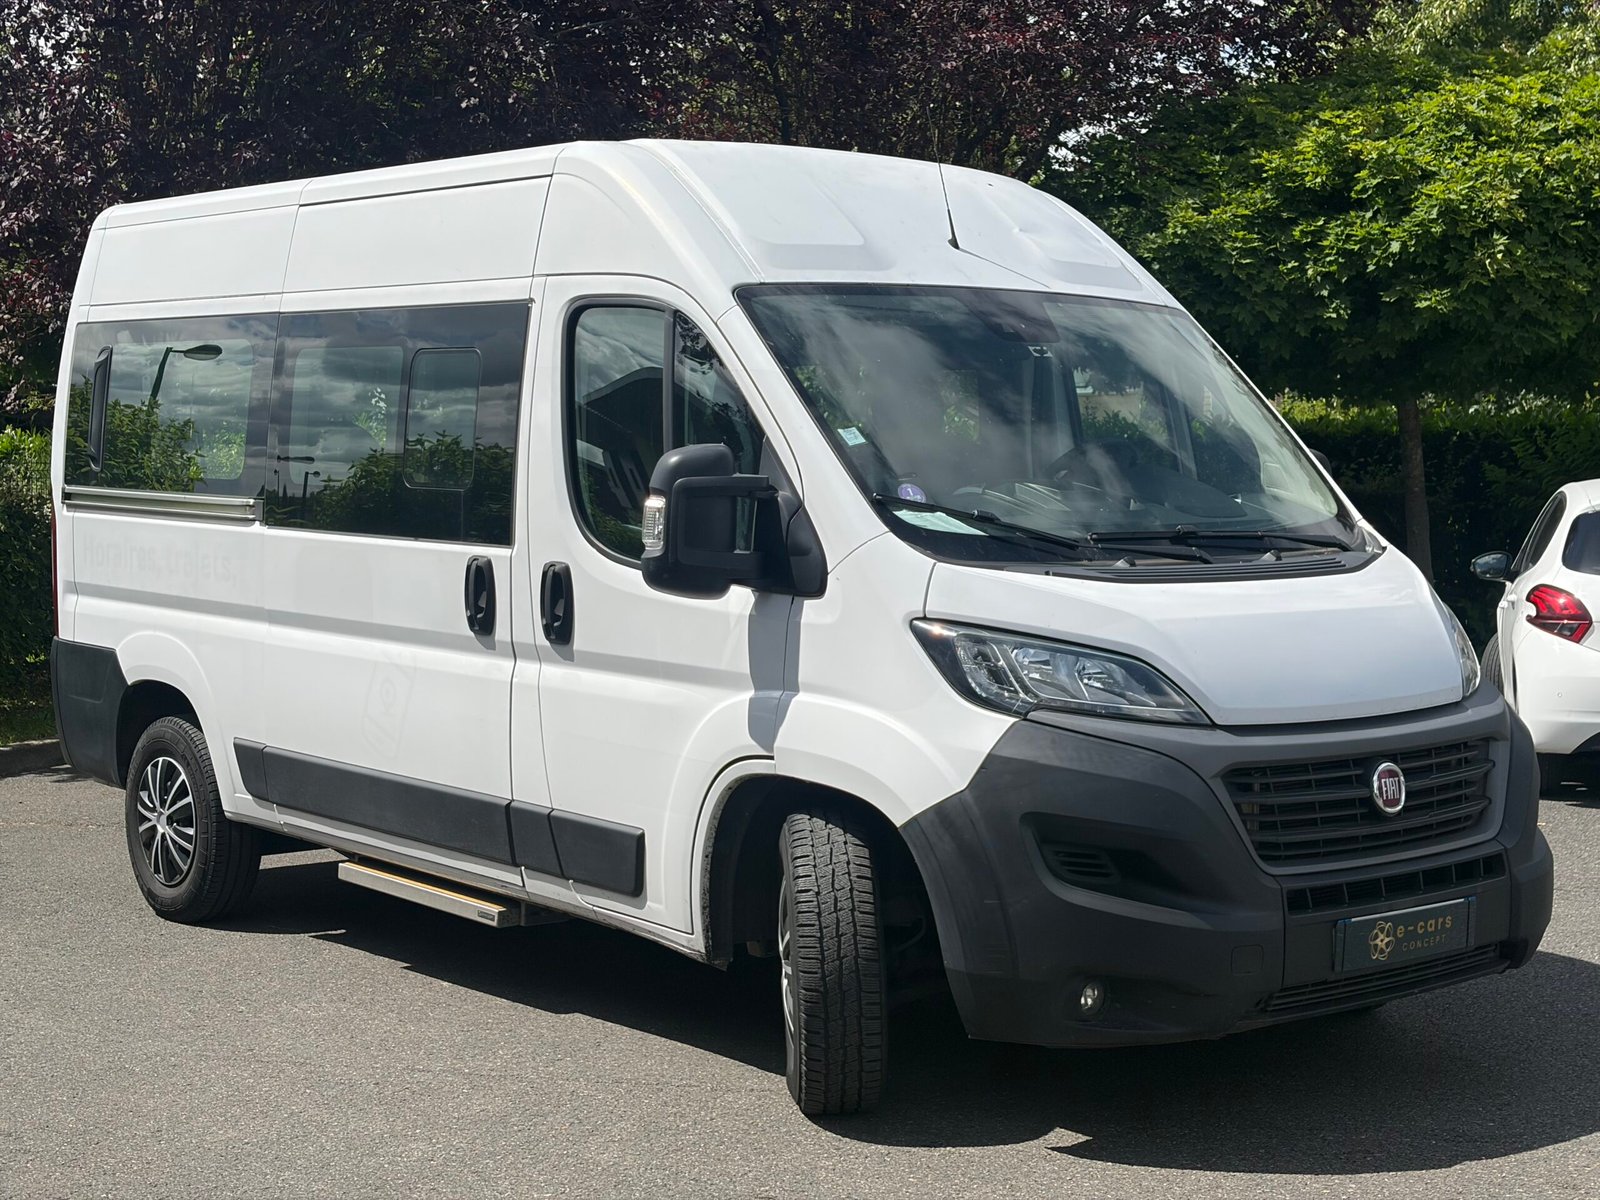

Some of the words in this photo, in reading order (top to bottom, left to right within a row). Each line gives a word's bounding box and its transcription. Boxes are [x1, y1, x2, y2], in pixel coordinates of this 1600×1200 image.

[1381, 777, 1400, 800] FIAT
[1396, 915, 1452, 938] e-cars
[1402, 934, 1446, 951] CONCEPT
